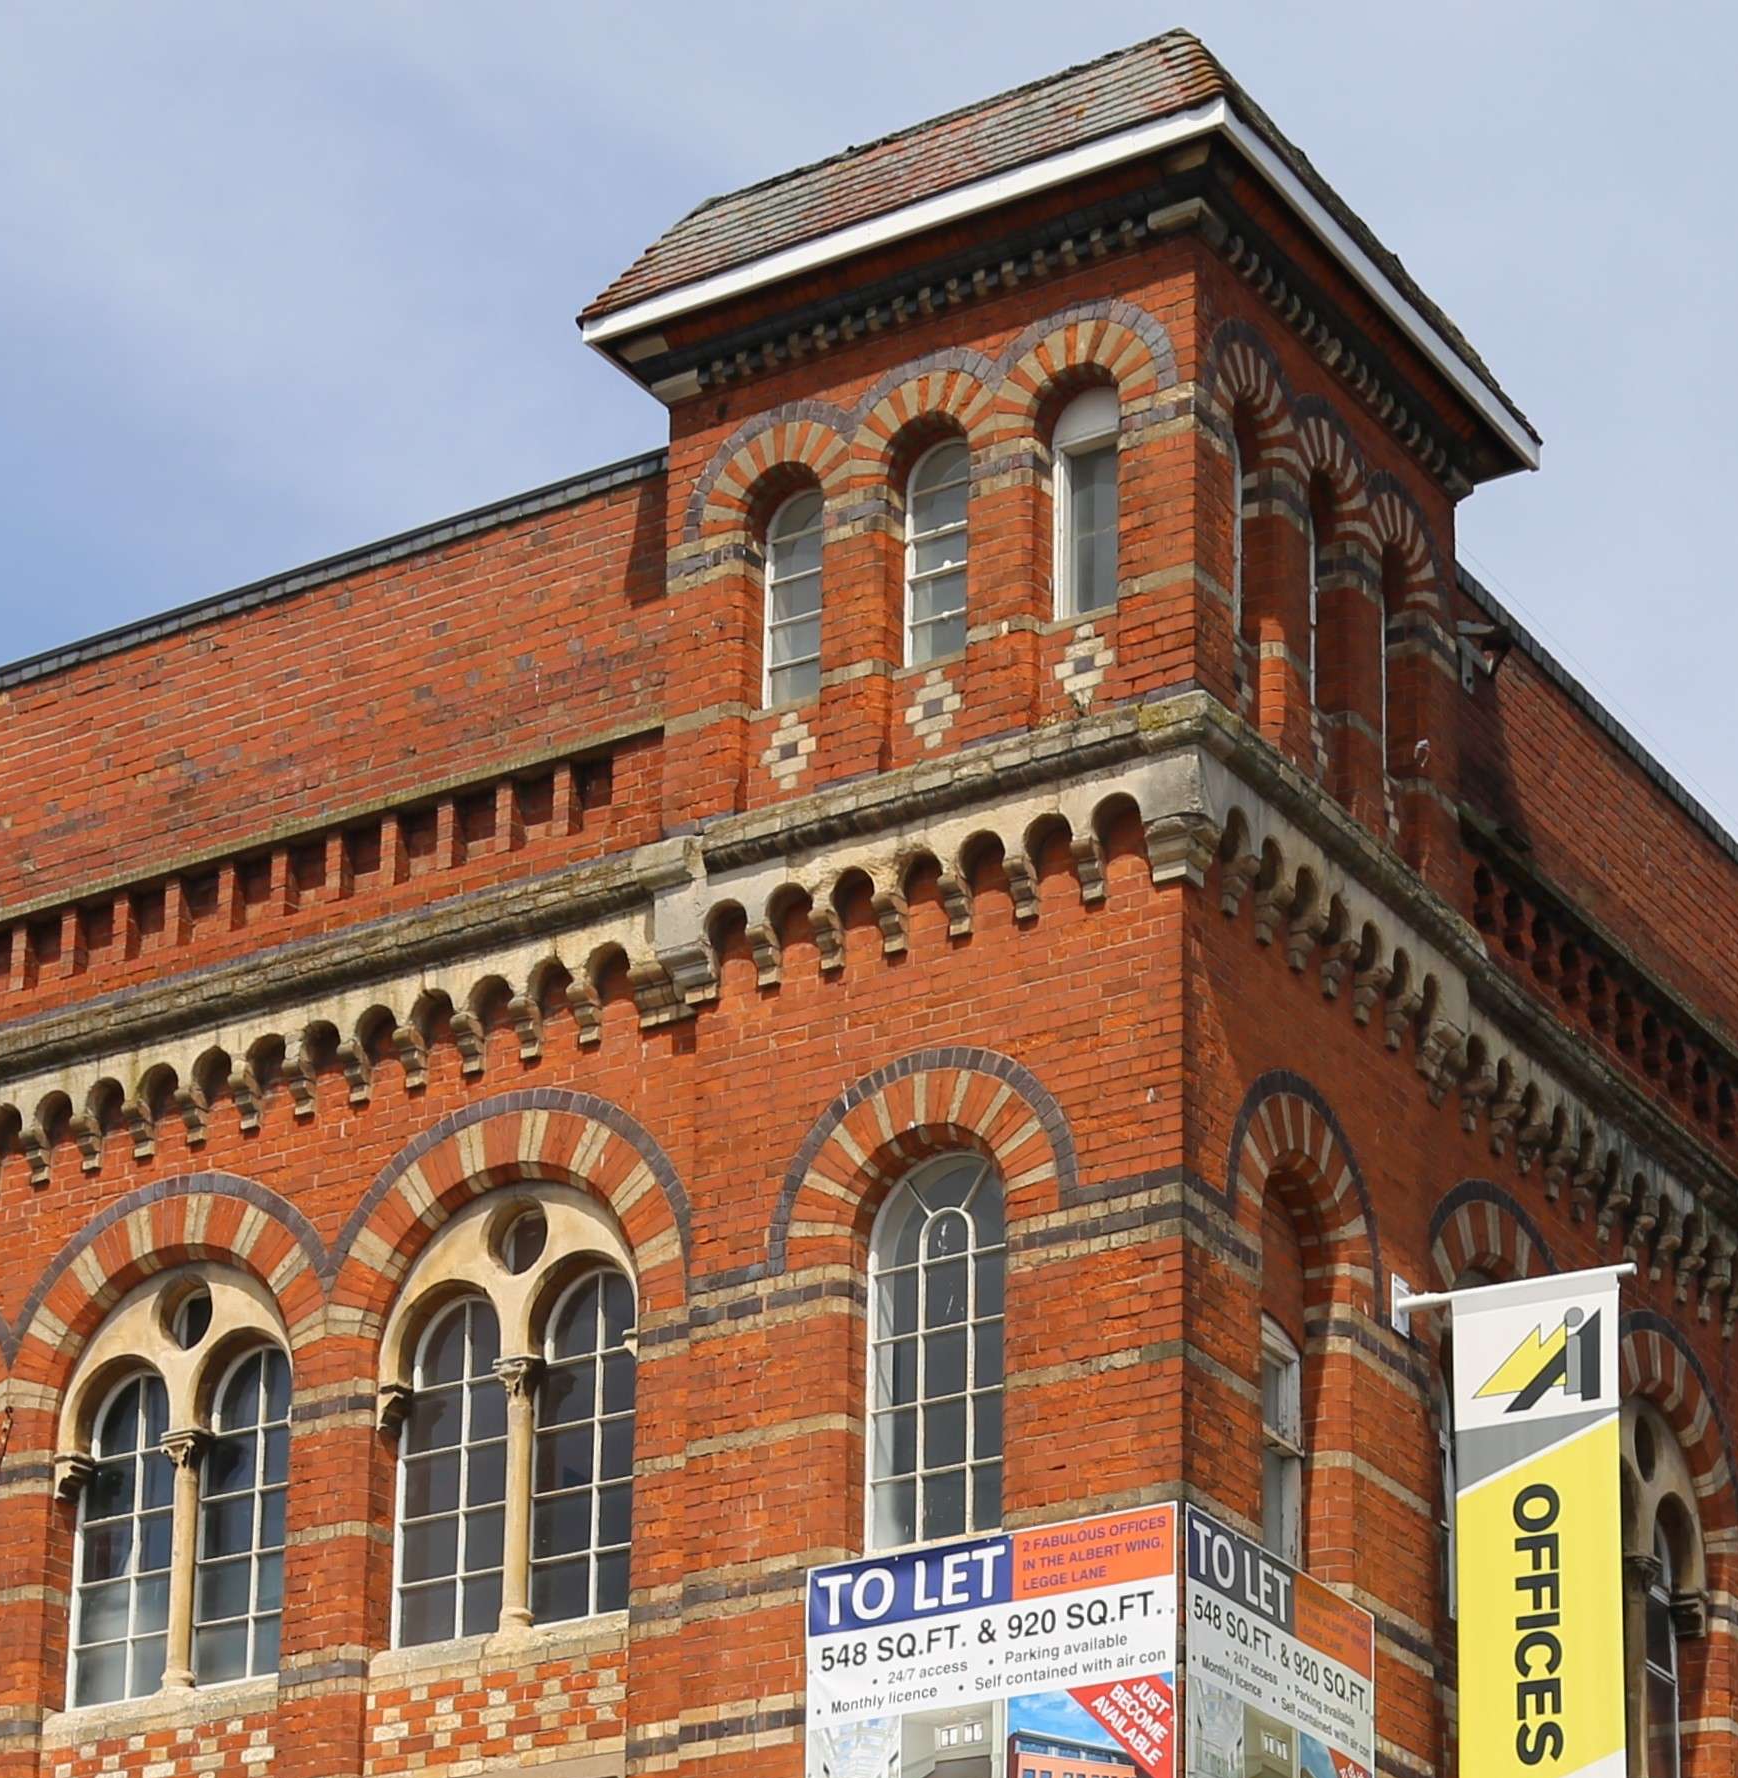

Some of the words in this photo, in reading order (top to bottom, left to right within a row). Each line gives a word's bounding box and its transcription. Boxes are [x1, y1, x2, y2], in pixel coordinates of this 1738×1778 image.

[1023, 1540, 1031, 1552] 2
[1033, 1527, 1106, 1551] FABULOUS
[1110, 1516, 1167, 1537] OFFICES
[1023, 1558, 1037, 1571] IN
[1040, 1553, 1065, 1569] THE
[1069, 1545, 1123, 1565] ALBERT
[1023, 1573, 1068, 1591] LEGGE
[1071, 1566, 1107, 1584] LANE
[1193, 1519, 1235, 1588] TO
[1244, 1550, 1292, 1623] LET
[818, 1568, 895, 1626] TO
[914, 1545, 1006, 1612] LET
[821, 1642, 867, 1672] 548
[876, 1625, 967, 1663] SQ.FT.
[977, 1619, 997, 1644] &
[1008, 1608, 1057, 1639] 920
[1066, 1591, 1163, 1628] SQ.FT.
[1513, 1483, 1563, 1766] OFFICES
[974, 1671, 1002, 1692] Self
[1006, 1661, 1078, 1686] contained
[1082, 1656, 1113, 1675] with
[1116, 1652, 1134, 1667] air
[1138, 1648, 1167, 1665] con
[1004, 1643, 1060, 1666] Parking
[1063, 1633, 1128, 1655] available
[1194, 1594, 1222, 1631] 548
[1226, 1611, 1277, 1662] SQ.FT.
[1280, 1643, 1290, 1669] &
[1294, 1652, 1319, 1686] 920
[1323, 1666, 1370, 1715] SQ.FT.
[887, 1668, 916, 1685] 24/7
[918, 1660, 969, 1680] access
[1201, 1655, 1234, 1686] Monthly
[1235, 1673, 1263, 1698] licence
[1251, 1663, 1278, 1686] access
[831, 1690, 885, 1715] Monthly
[888, 1685, 938, 1706] licence
[1109, 1684, 1169, 1745] BECOME
[1132, 1681, 1171, 1717] JUST
[1294, 1685, 1322, 1714] Parking
[1323, 1702, 1356, 1728] available
[1091, 1695, 1163, 1767] AVAILABLE
[1281, 1697, 1295, 1716] Self
[1297, 1707, 1333, 1737] contained
[1334, 1727, 1349, 1746] with
